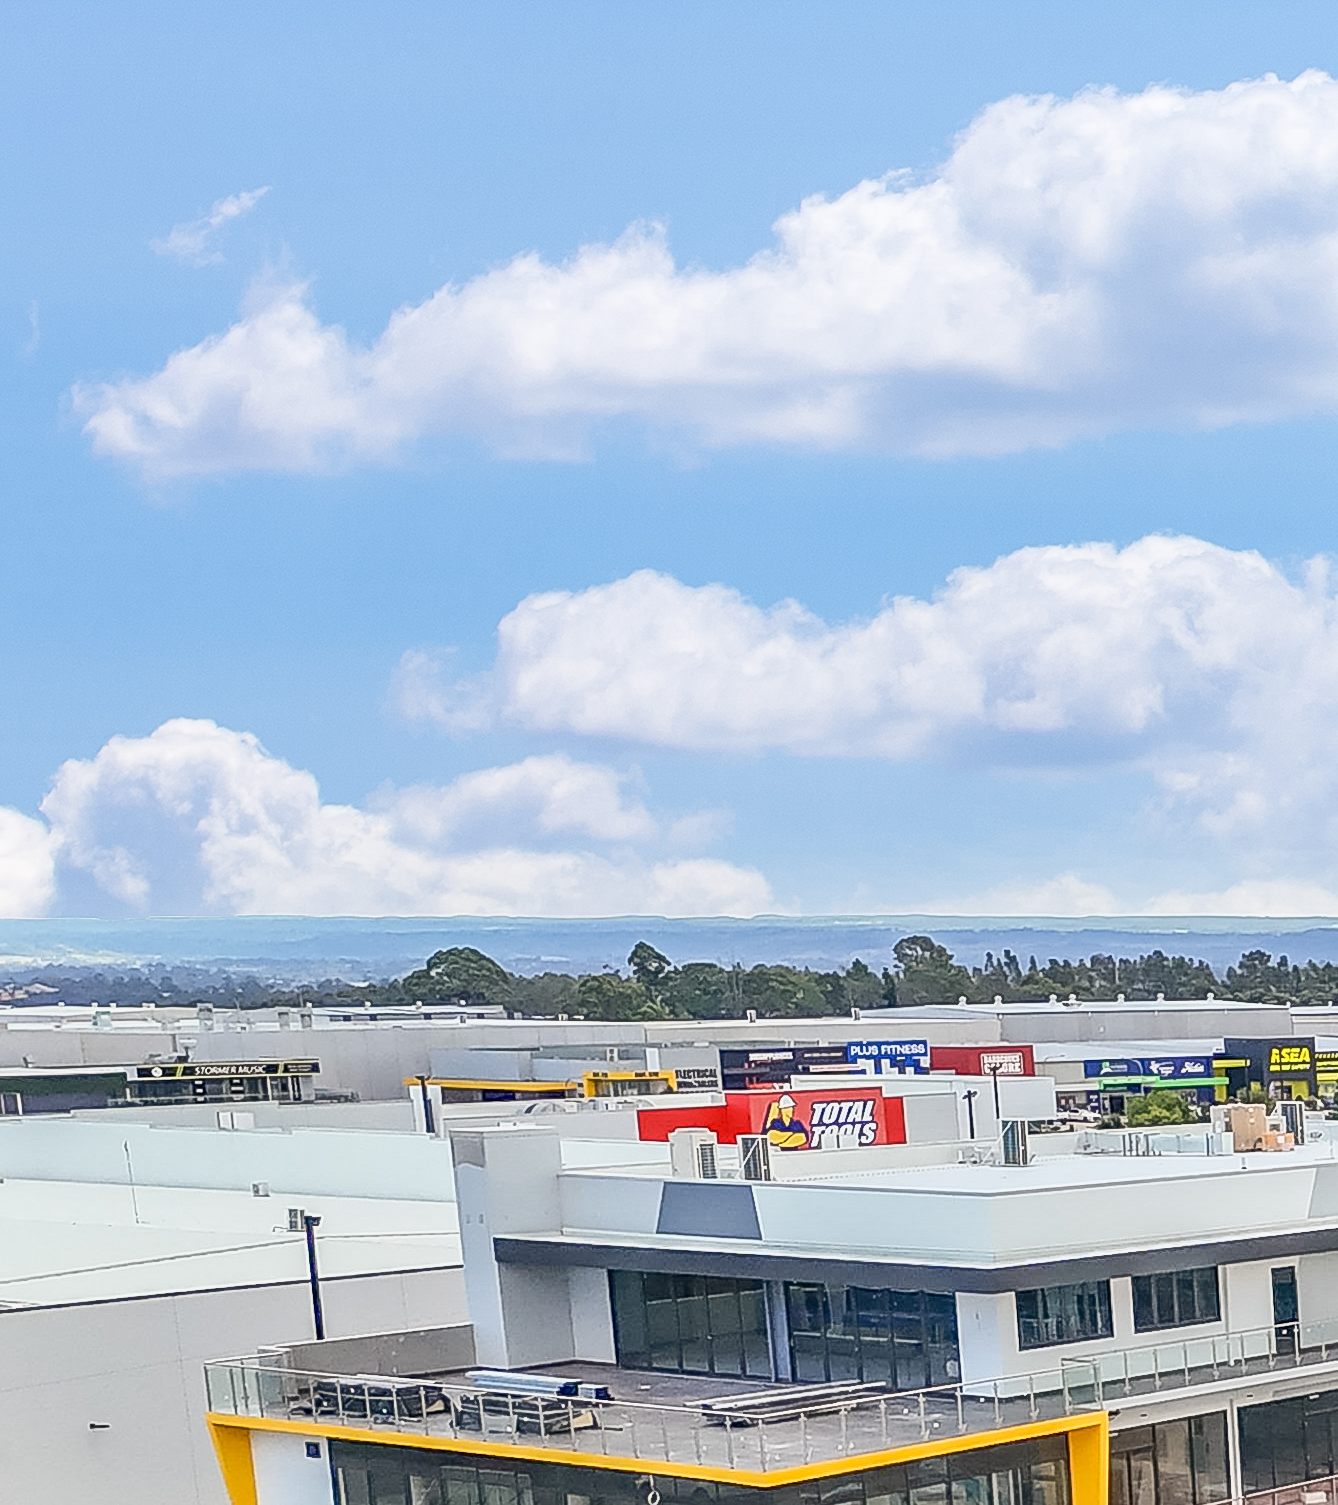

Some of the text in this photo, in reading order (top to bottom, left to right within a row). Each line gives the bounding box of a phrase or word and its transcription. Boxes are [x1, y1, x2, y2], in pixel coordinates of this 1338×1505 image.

[850, 1044, 878, 1056] PLUS
[880, 1043, 926, 1055] FITNESS
[811, 1100, 876, 1125] TOTAL
[810, 1122, 877, 1148] TOOLS
